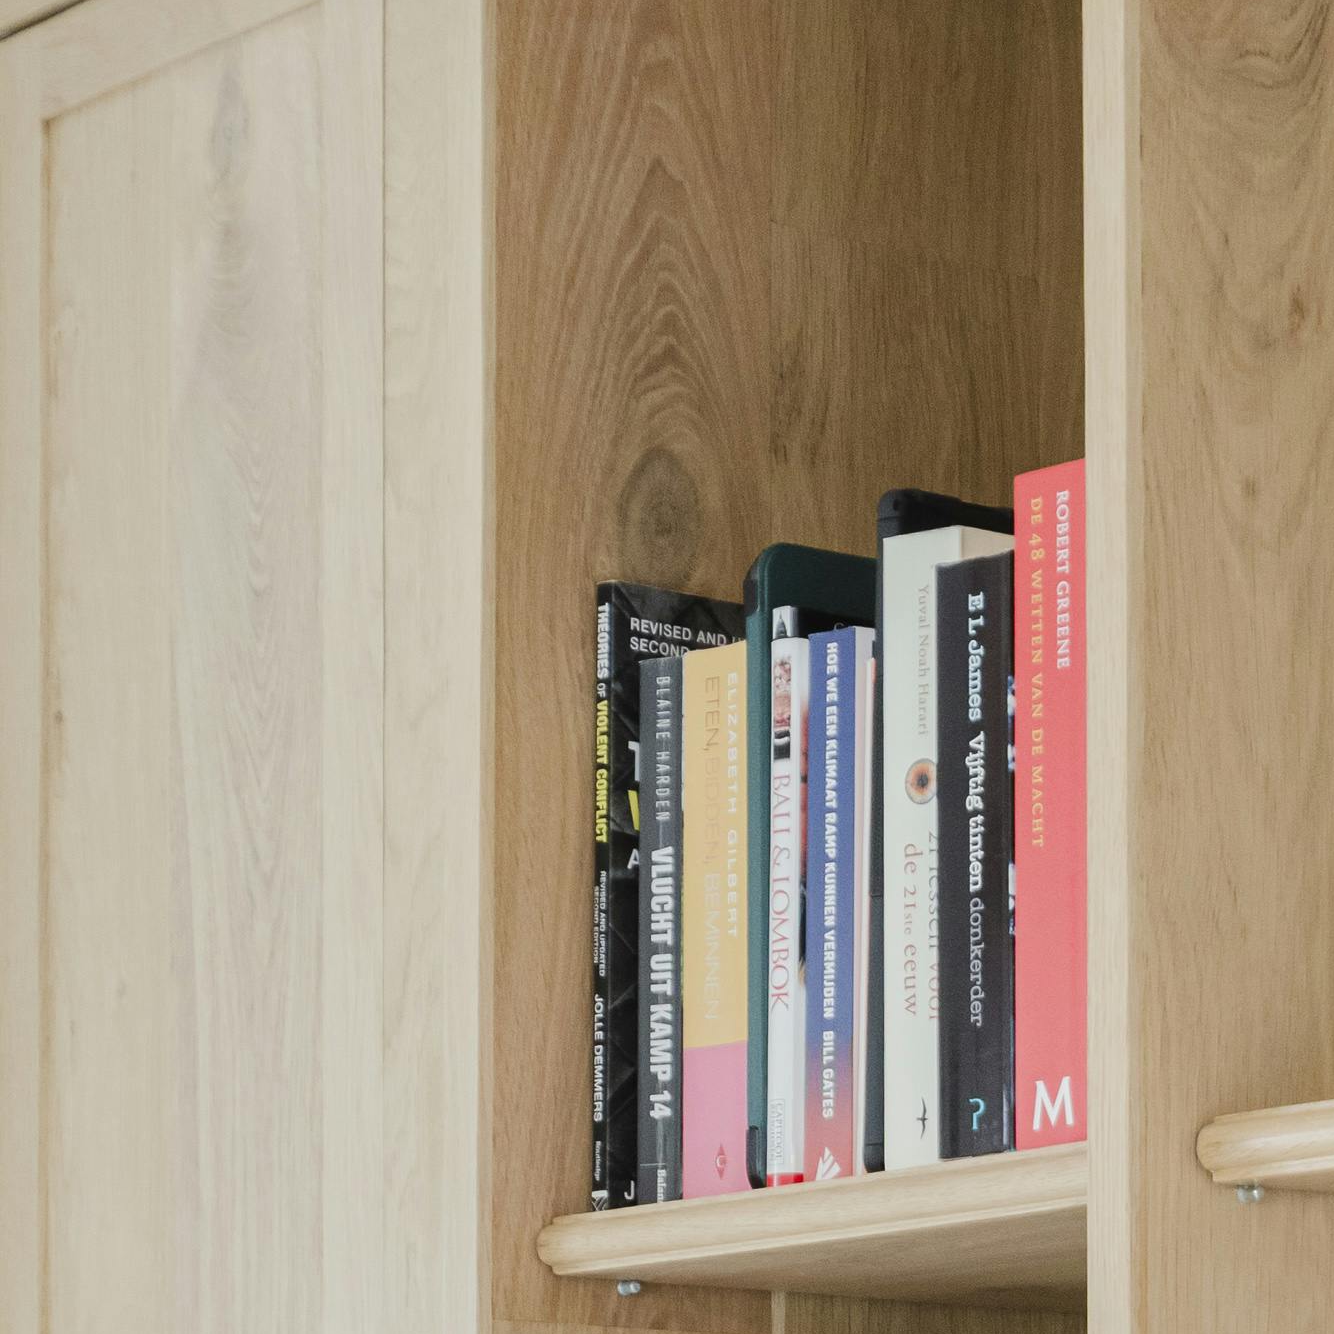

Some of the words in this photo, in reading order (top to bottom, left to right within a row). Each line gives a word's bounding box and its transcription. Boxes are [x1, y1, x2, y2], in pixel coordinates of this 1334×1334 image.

[1030, 497, 1043, 524] DE
[1056, 490, 1070, 574] ROBERT
[1029, 533, 1046, 560] 48
[918, 584, 930, 628] Yuval
[968, 591, 985, 611] E
[968, 615, 985, 636] L
[1031, 570, 1043, 663] WETTEN
[1056, 581, 1071, 669] GREENE
[596, 602, 610, 680] THEORIES
[630, 617, 693, 641] REVISED
[696, 630, 728, 646] AND
[827, 642, 839, 676] HOE
[918, 634, 930, 677] Noah
[596, 682, 607, 698] OF
[656, 676, 671, 740] BLAINE
[826, 677, 839, 703] WE
[918, 683, 929, 736] Harari
[968, 639, 985, 723] James
[1031, 673, 1043, 718] VAN
[596, 699, 609, 765] VIOLENT
[704, 675, 720, 751] ETEN,
[826, 706, 838, 738] EEN
[1031, 728, 1044, 755] DE
[727, 672, 738, 813] ELIZABETH
[656, 751, 671, 820] HARDEN
[825, 739, 838, 808] KLIMAAT
[965, 731, 986, 812] Vijftig
[595, 768, 608, 843] CONFLICT
[772, 774, 791, 835] BALI
[1031, 766, 1044, 847] MACHT
[772, 845, 791, 866] &
[825, 812, 837, 859] RAMP
[904, 843, 923, 875] de
[969, 814, 985, 893] tinten
[599, 870, 608, 910] REVISED
[651, 845, 675, 947] VLUCHT
[727, 829, 738, 938] GILBERT
[824, 862, 837, 927] KUNNEN
[599, 912, 607, 932] AND
[771, 876, 791, 1011] LOMBOK
[598, 934, 607, 977] UPDATED
[650, 953, 674, 996] UIT
[823, 929, 836, 1019] VERMIJDEN
[904, 944, 918, 1016] eeuw
[970, 897, 985, 1027] donkerder
[594, 994, 605, 1041] JOLLE
[650, 1003, 674, 1083] KAMP
[823, 1030, 835, 1065] BILL
[593, 1044, 604, 1123] DEMMERS
[649, 1089, 673, 1119] 14
[822, 1068, 834, 1119] GATES
